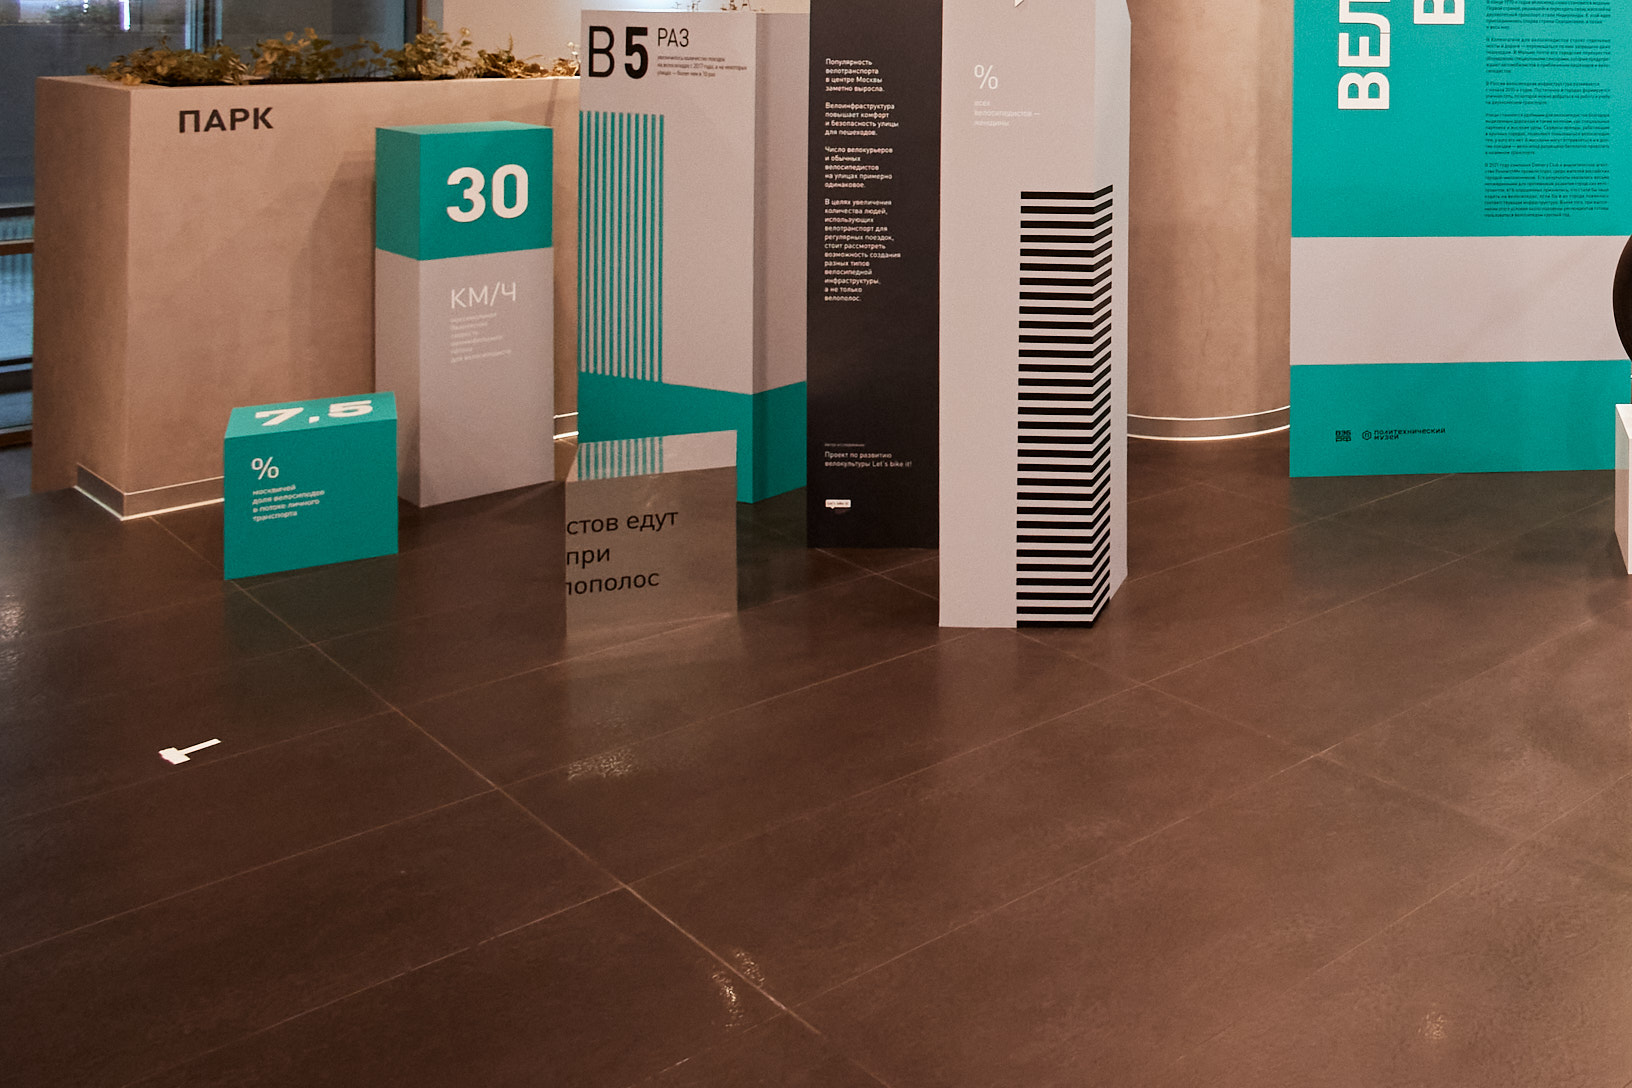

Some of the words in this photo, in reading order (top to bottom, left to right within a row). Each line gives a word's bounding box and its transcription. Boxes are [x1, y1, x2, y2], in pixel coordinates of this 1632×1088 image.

[589, 26, 615, 78] В
[625, 27, 649, 80] 5
[658, 28, 689, 48] РАЗ
[825, 58, 872, 66] Популярность
[855, 75, 882, 83] Москвы
[975, 65, 999, 90] %
[179, 107, 273, 134] ПАРК
[447, 164, 529, 223] 30
[452, 282, 517, 309] КМ/Ч
[252, 457, 280, 480] %
[566, 517, 619, 536] стов
[626, 511, 679, 532] едут
[566, 547, 610, 569] при
